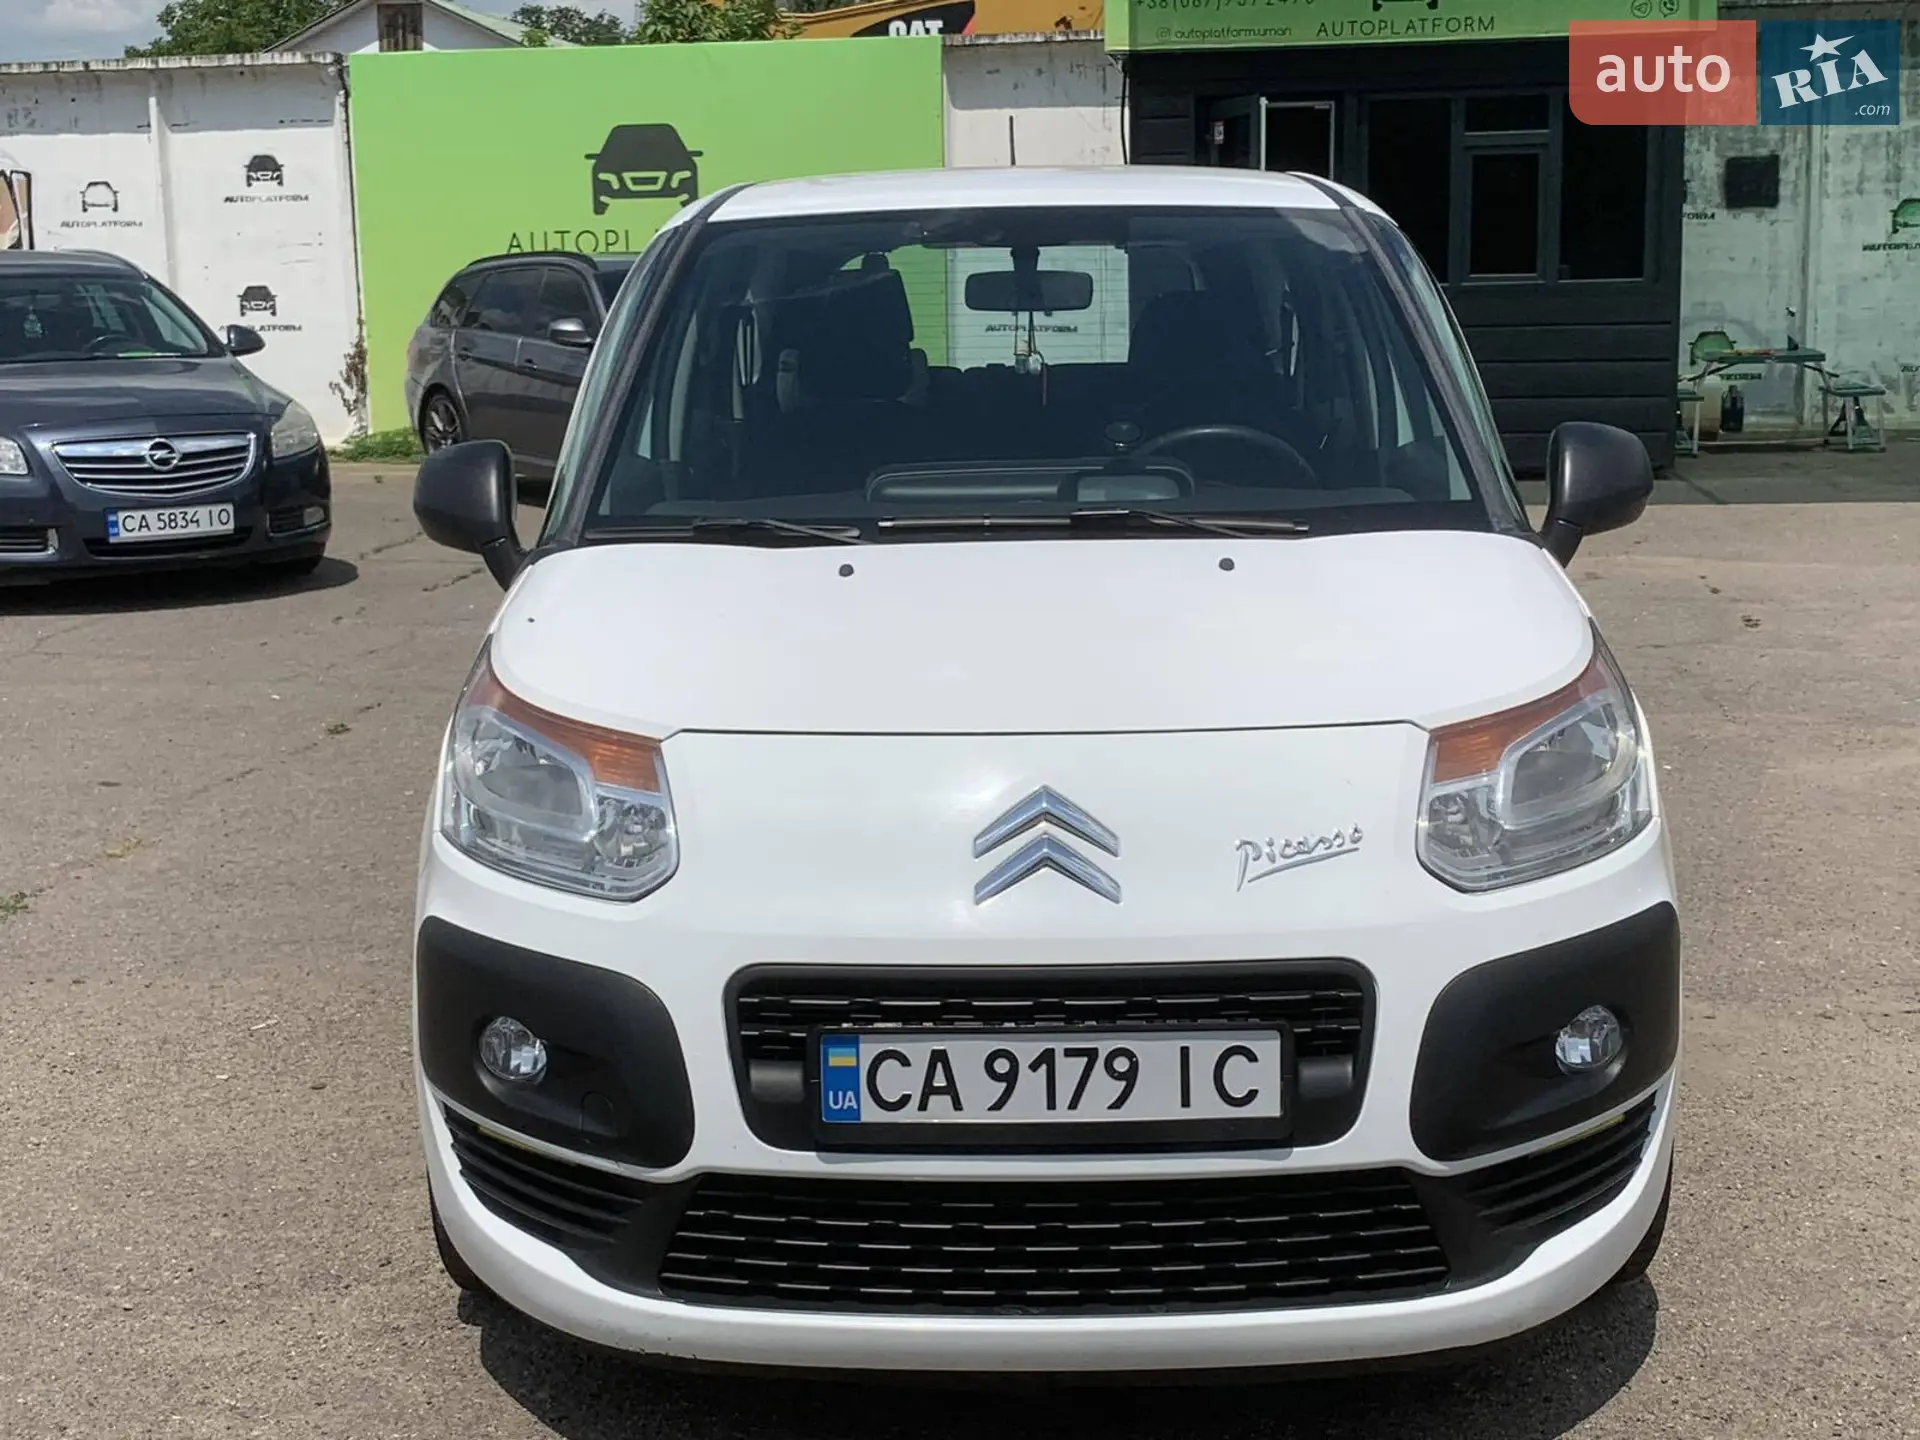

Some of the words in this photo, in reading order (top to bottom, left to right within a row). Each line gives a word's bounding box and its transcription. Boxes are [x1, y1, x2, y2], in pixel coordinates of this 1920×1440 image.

[1316, 15, 1495, 37] AUTOPLATFORM
[122, 514, 151, 533] CA
[157, 510, 200, 530] 5834
[1236, 824, 1363, 892] Picasso
[865, 1046, 964, 1112] CA
[983, 1045, 1140, 1112] 9179
[1180, 1043, 1260, 1108] IC
[828, 1090, 859, 1110] UA
